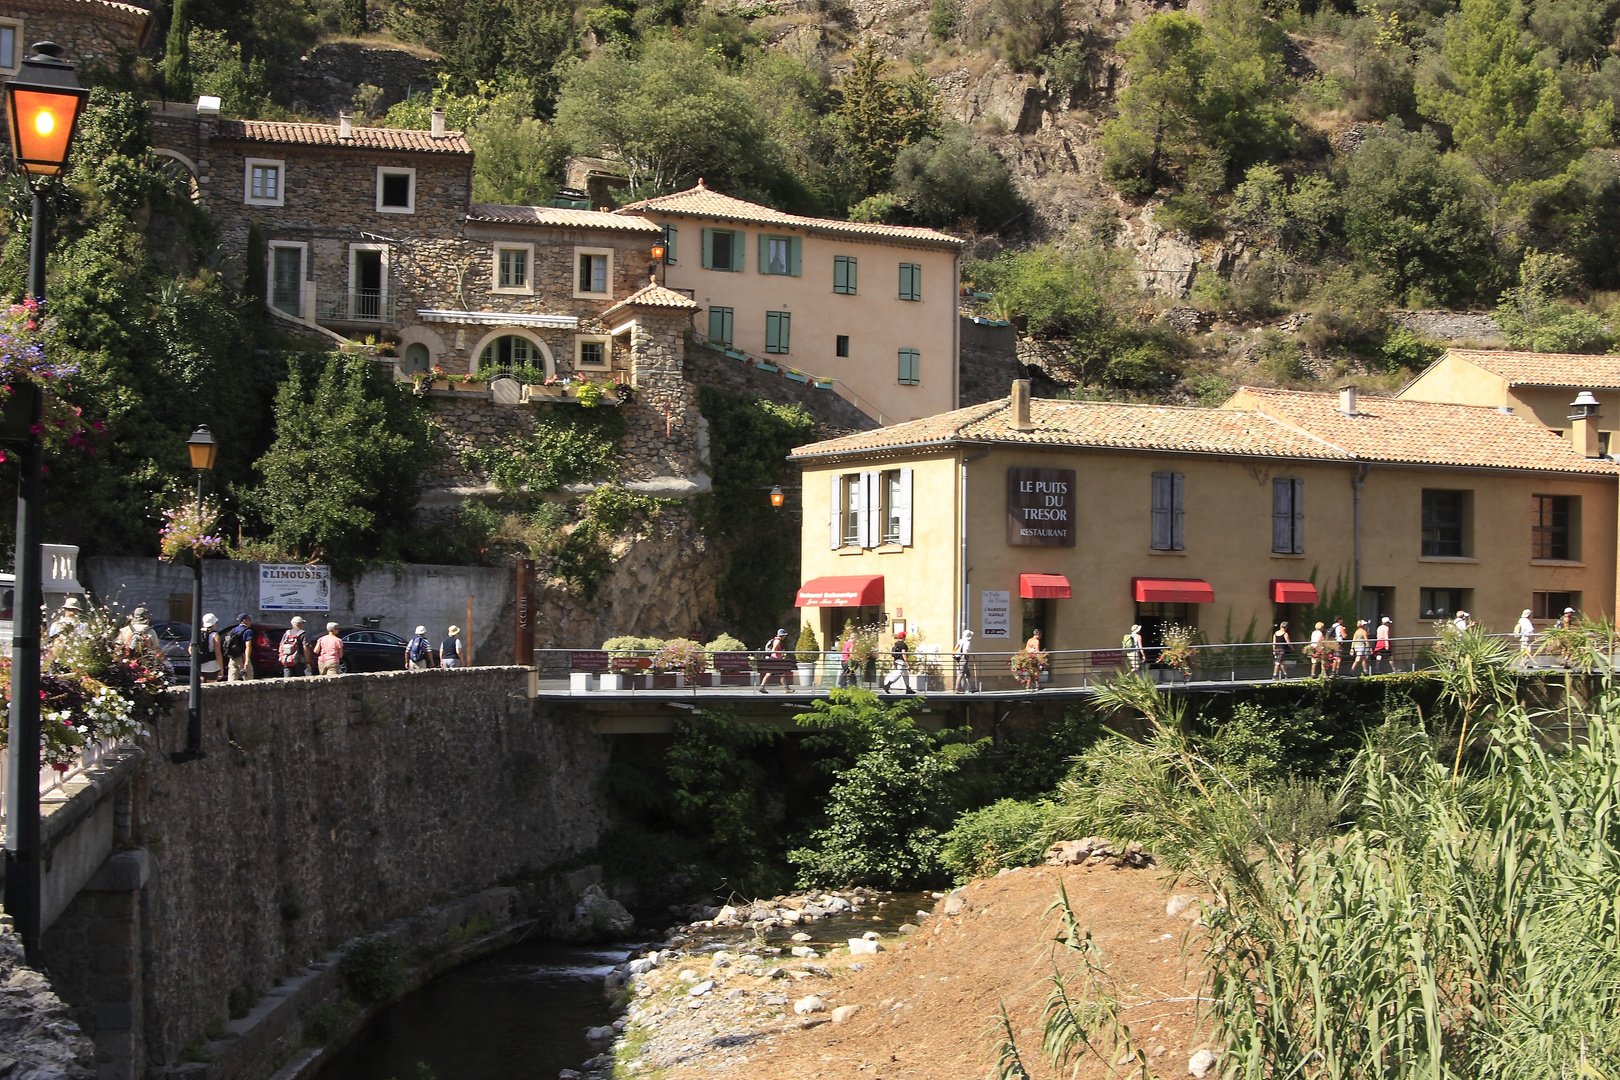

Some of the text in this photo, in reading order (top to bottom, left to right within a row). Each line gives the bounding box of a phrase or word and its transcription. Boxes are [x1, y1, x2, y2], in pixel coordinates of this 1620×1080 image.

[1020, 481, 1068, 494] LE PUITS
[1045, 495, 1064, 507] DU
[1022, 508, 1067, 521] TRESOR
[1020, 528, 1067, 537] RESTAURANT
[269, 570, 322, 579] LIMOUSIS
